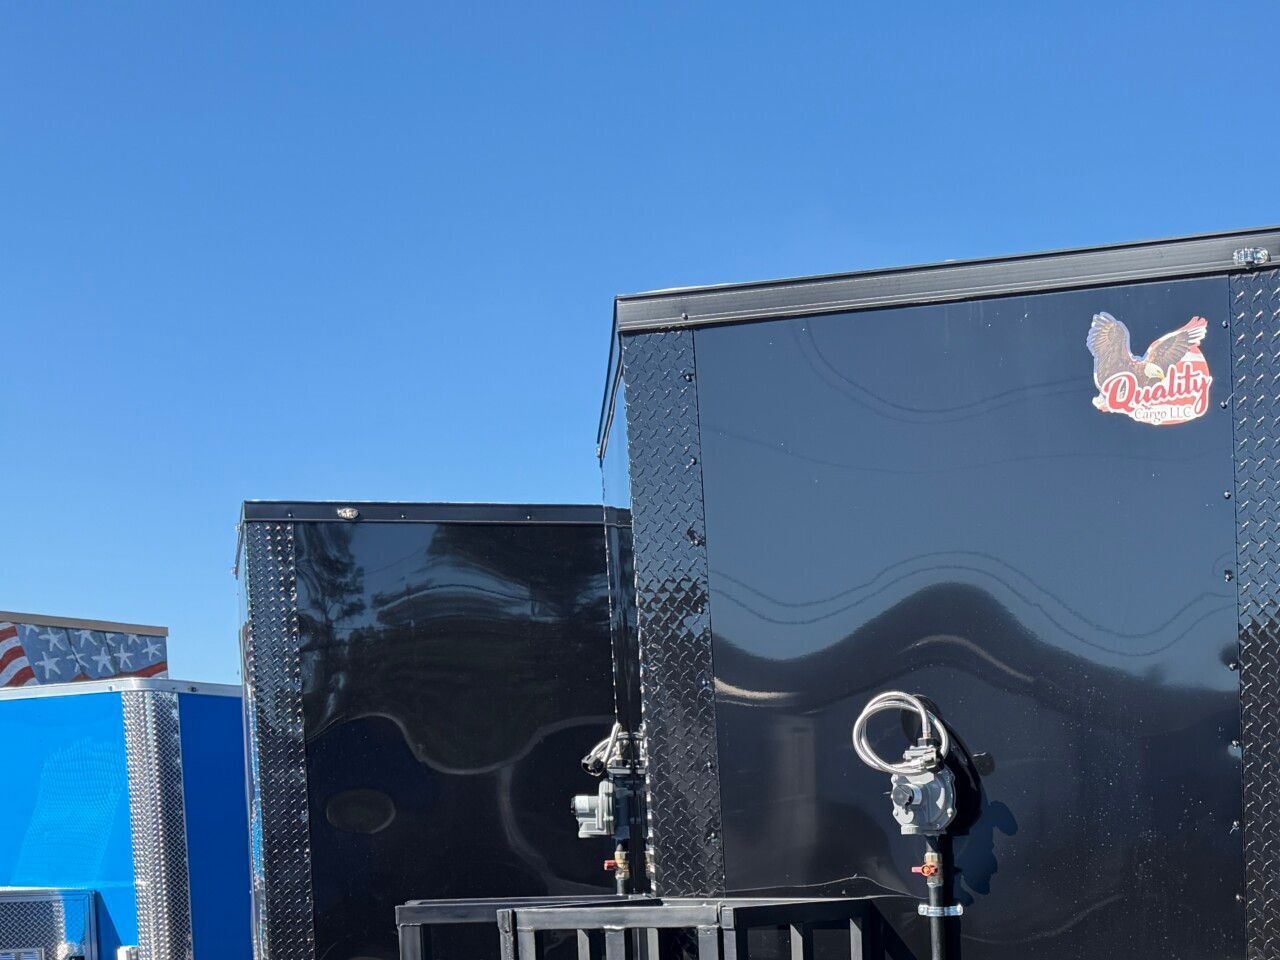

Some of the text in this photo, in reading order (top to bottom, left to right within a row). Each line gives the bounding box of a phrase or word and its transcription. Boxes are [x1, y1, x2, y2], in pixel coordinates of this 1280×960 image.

[1103, 363, 1209, 415] Quality
[1134, 405, 1192, 422] Cargo LLC
